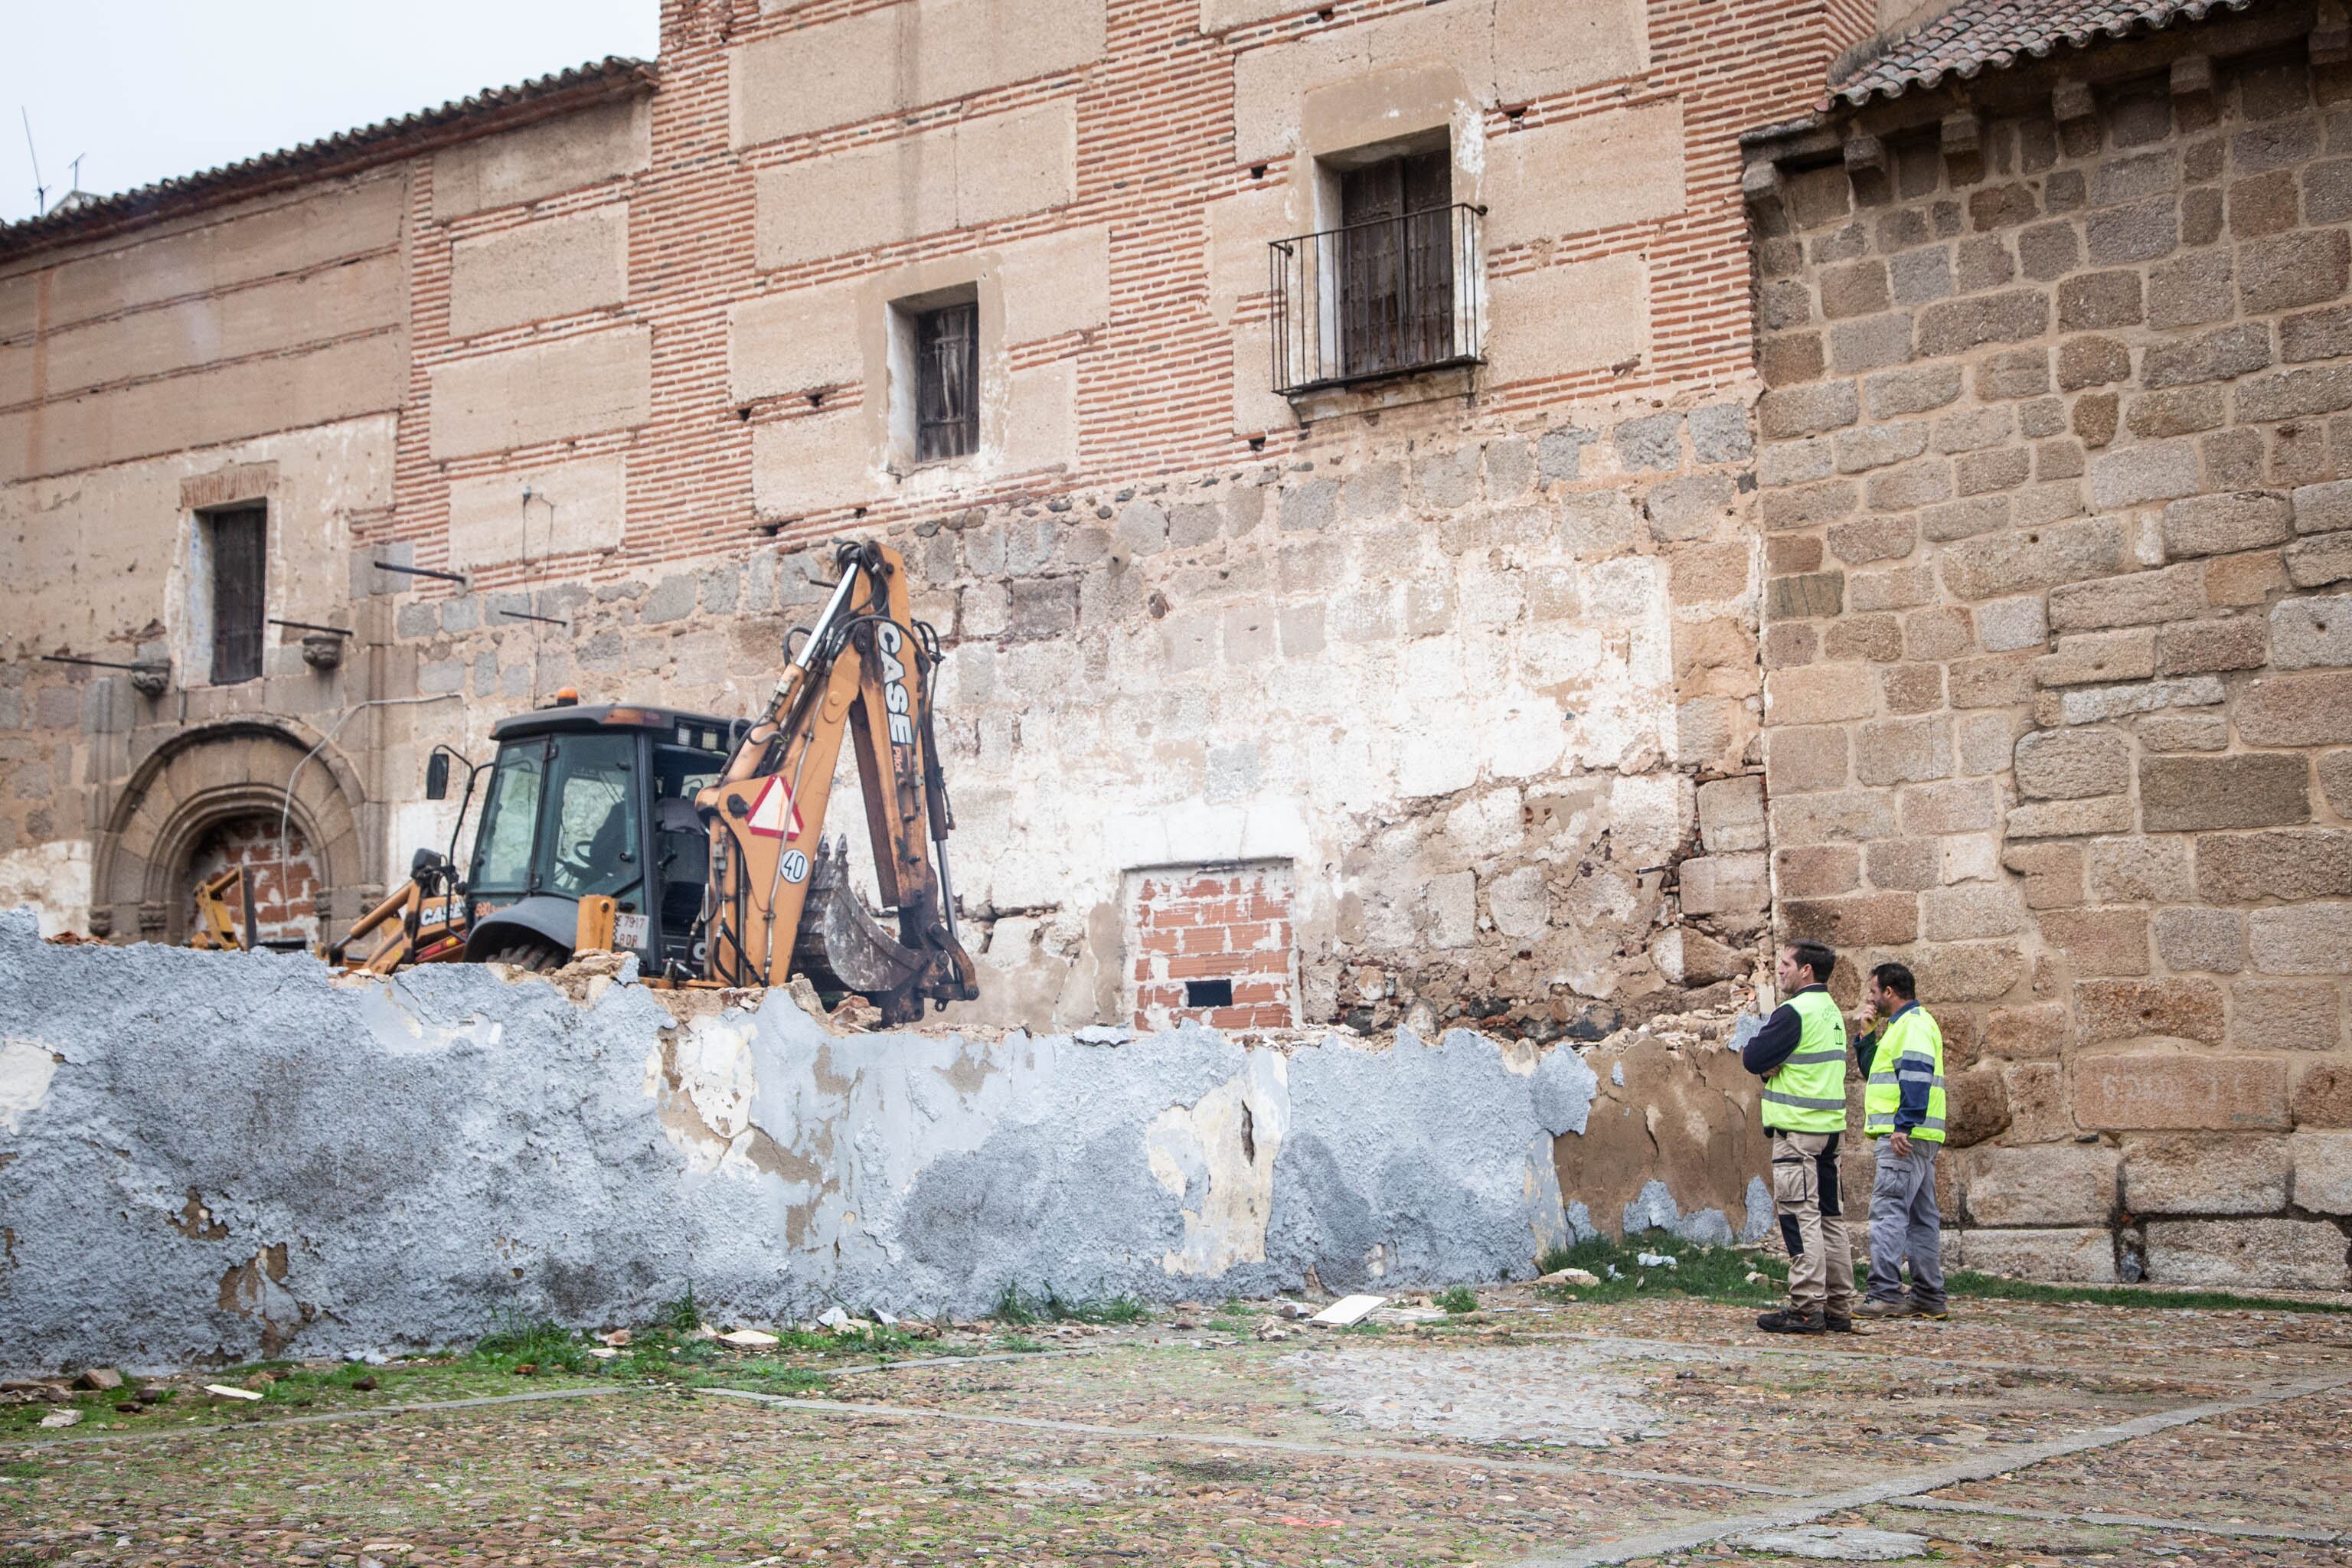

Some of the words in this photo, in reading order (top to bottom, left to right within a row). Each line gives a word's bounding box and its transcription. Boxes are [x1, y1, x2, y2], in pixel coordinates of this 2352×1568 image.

[877, 621, 913, 744] CASE
[893, 746, 904, 773] Pilot
[783, 851, 805, 880] 40
[421, 903, 465, 925] CASE
[624, 916, 645, 929] 7917
